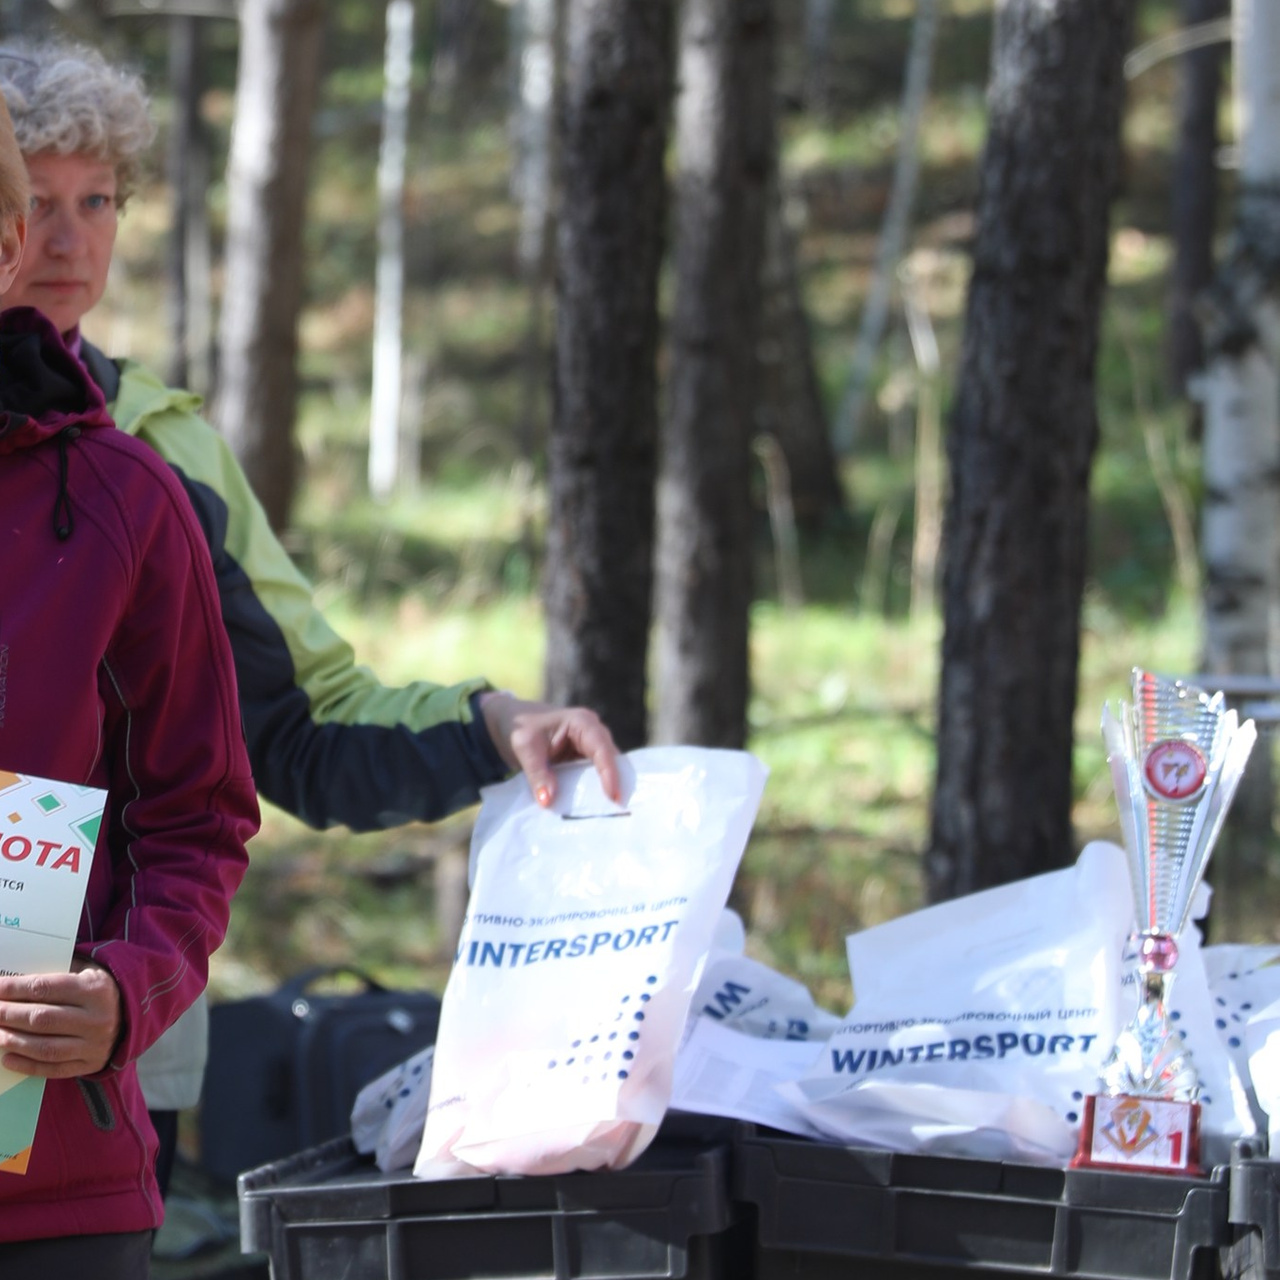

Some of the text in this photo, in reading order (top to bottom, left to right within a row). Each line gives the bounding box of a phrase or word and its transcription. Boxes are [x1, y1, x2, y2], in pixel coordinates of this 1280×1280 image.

[461, 920, 680, 968] INTERSPORT
[831, 1032, 1098, 1074] WINTERSPORT
[1167, 1131, 1183, 1165] 1
